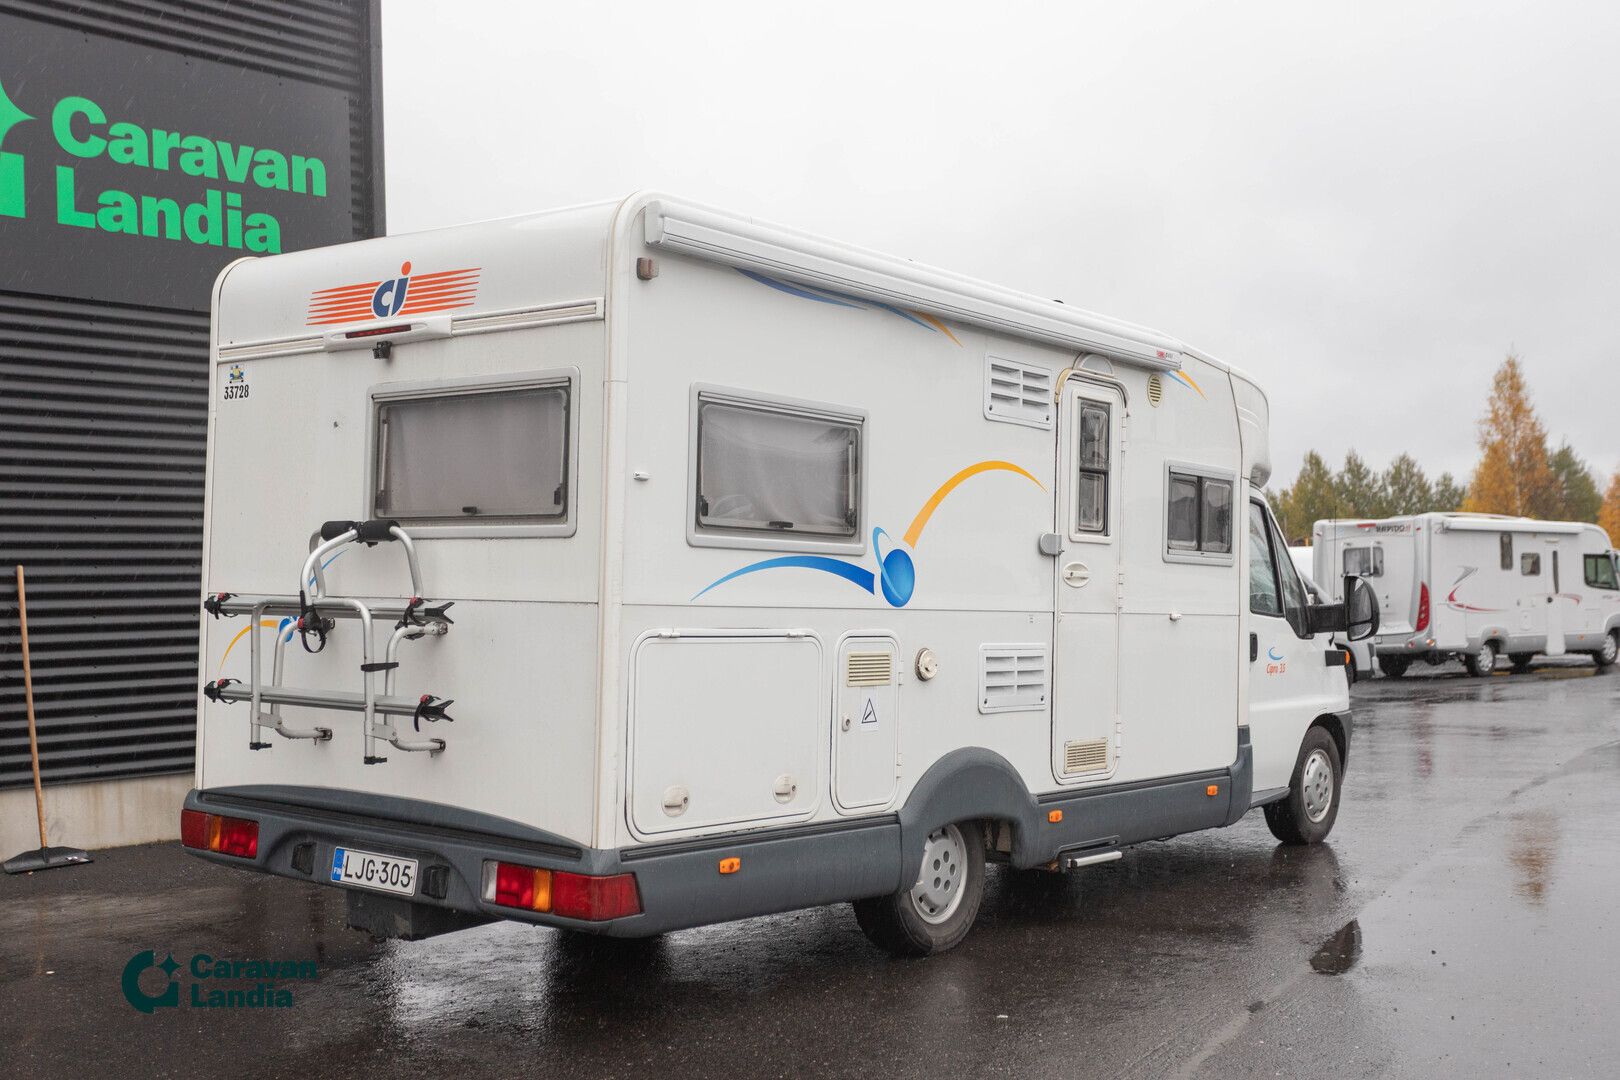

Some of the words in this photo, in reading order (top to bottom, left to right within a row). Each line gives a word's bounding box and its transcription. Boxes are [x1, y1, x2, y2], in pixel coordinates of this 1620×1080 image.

[51, 96, 327, 197] Caravan
[56, 165, 282, 254] Landia
[224, 384, 250, 400] 33728
